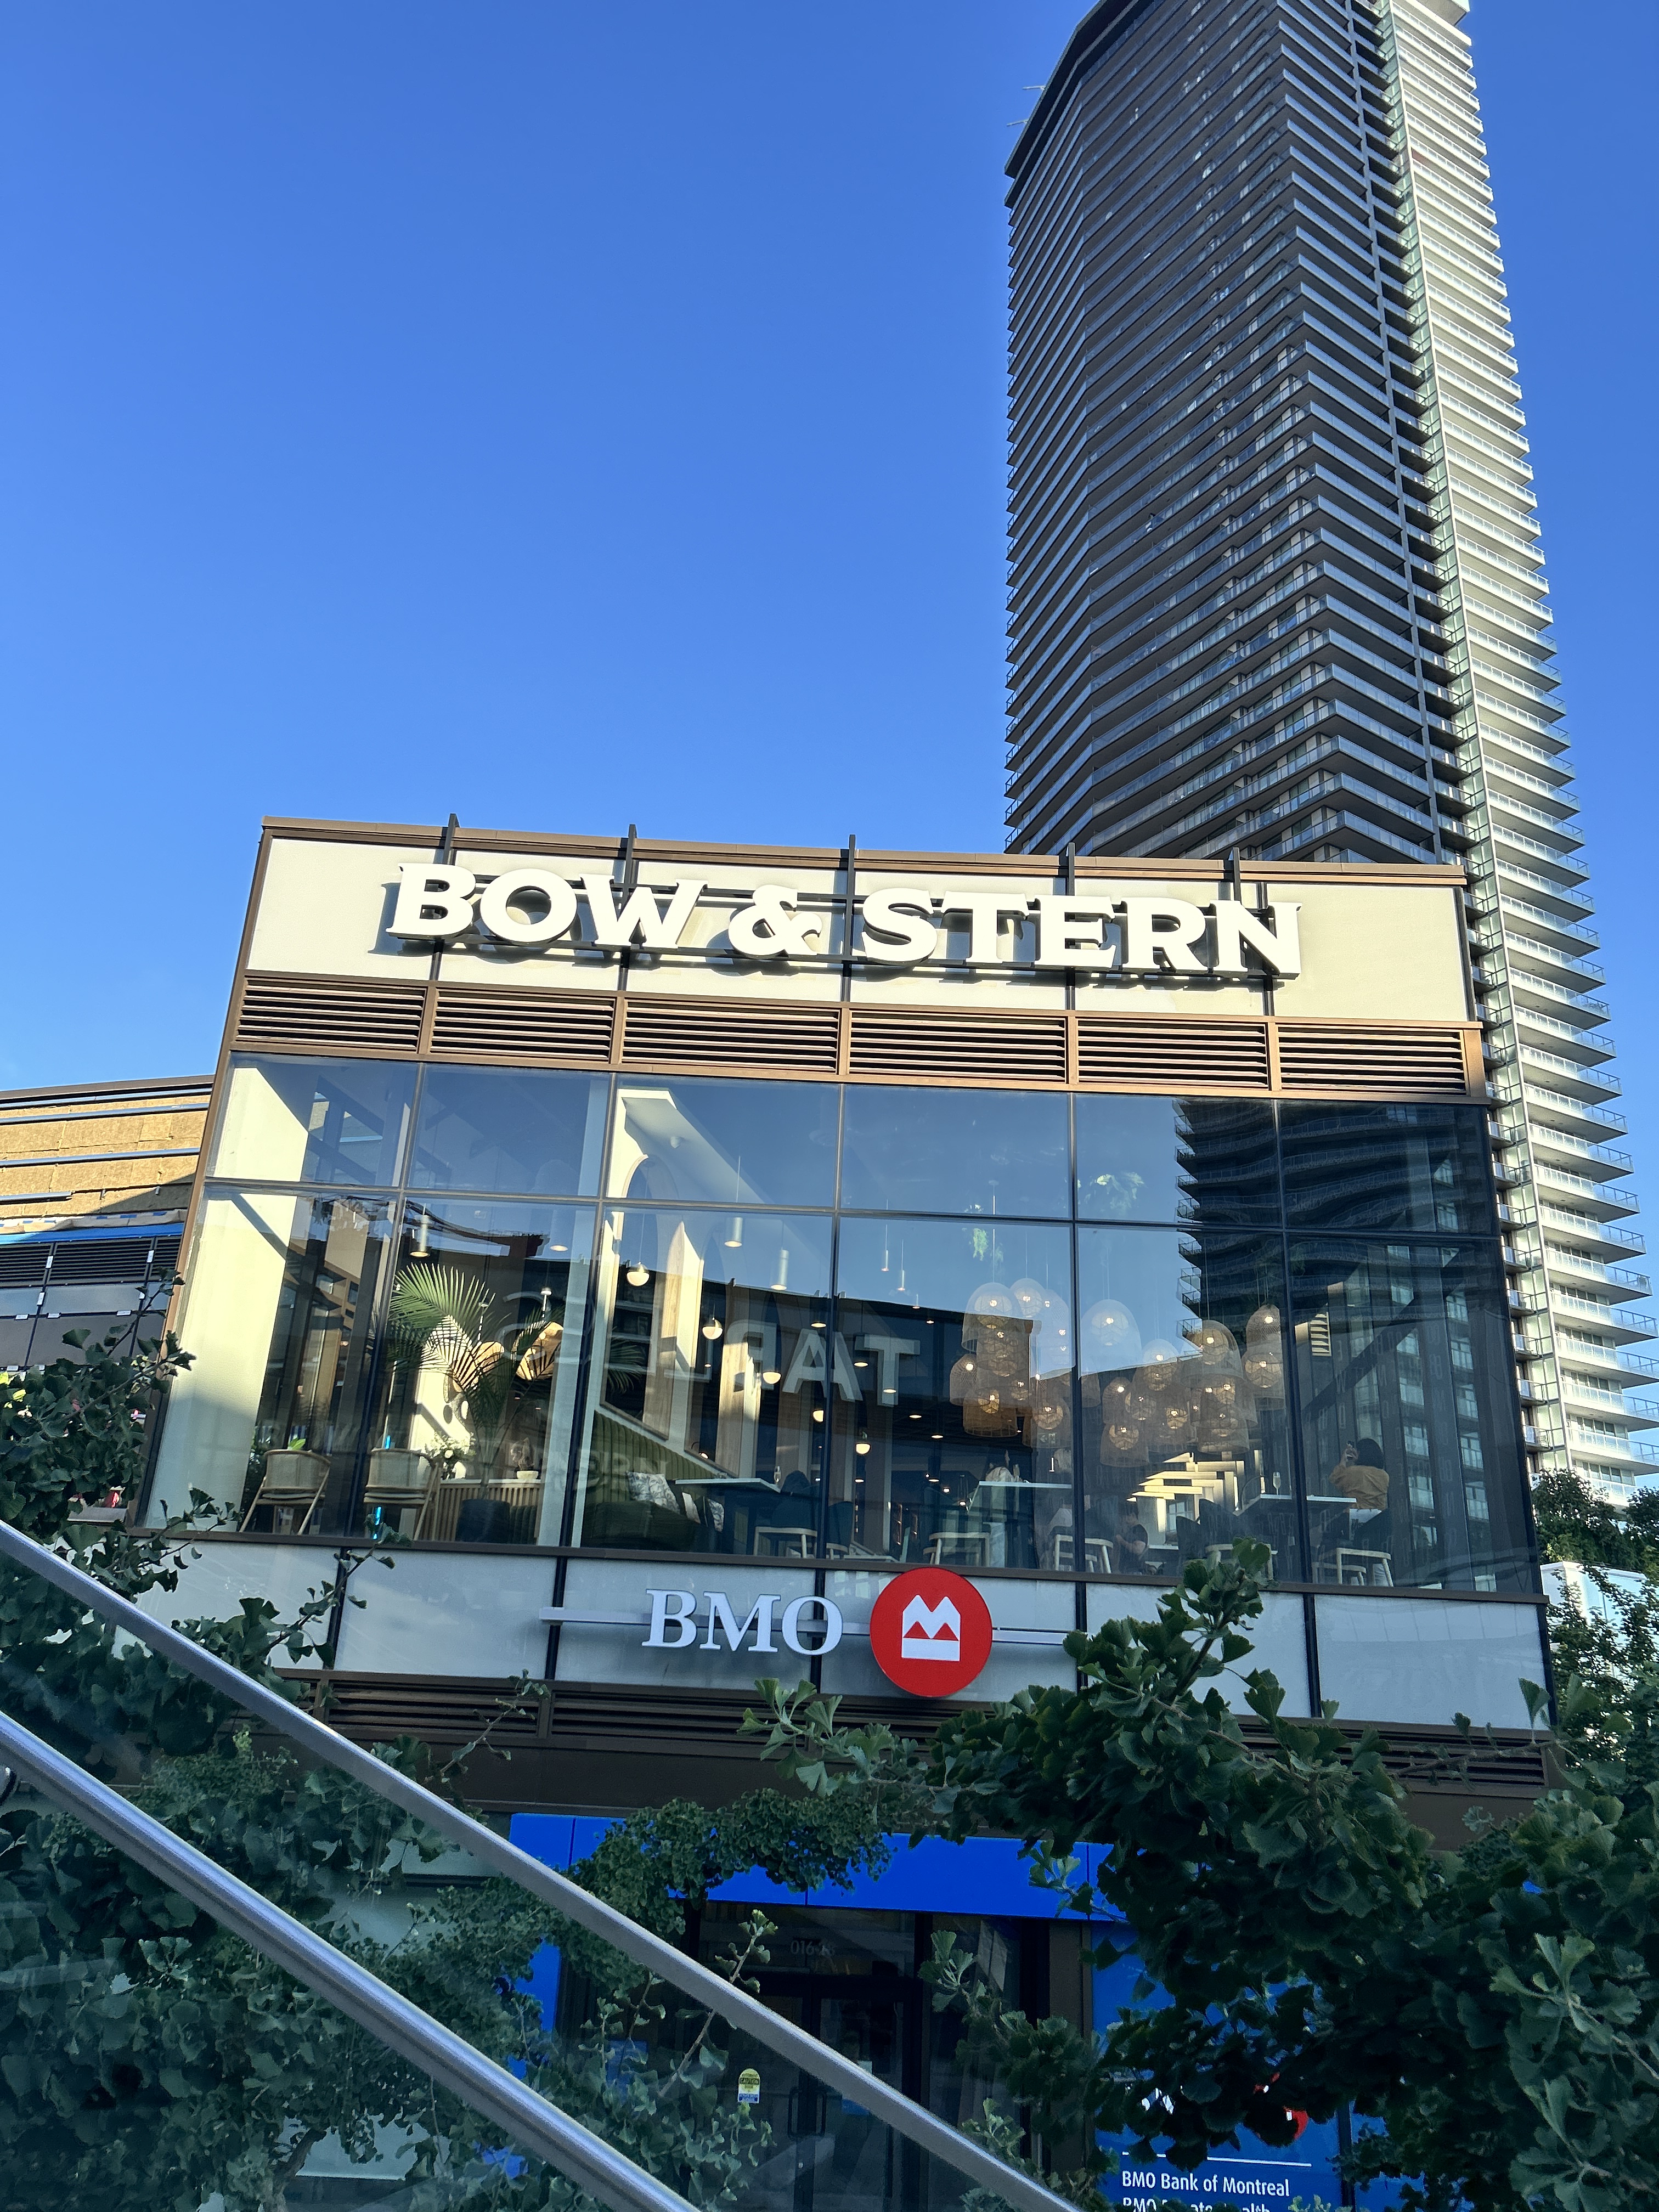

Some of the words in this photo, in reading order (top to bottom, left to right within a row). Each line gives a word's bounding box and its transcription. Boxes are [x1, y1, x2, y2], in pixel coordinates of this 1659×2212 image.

[386, 863, 708, 948] BOW
[729, 884, 822, 957] &
[862, 888, 1302, 979] STERN
[642, 1589, 843, 1656] BMO
[1122, 2170, 1156, 2188] BMO
[1161, 2172, 1199, 2191] Bank
[1203, 2174, 1218, 2193] of
[1223, 2176, 1290, 2197] Montreal
